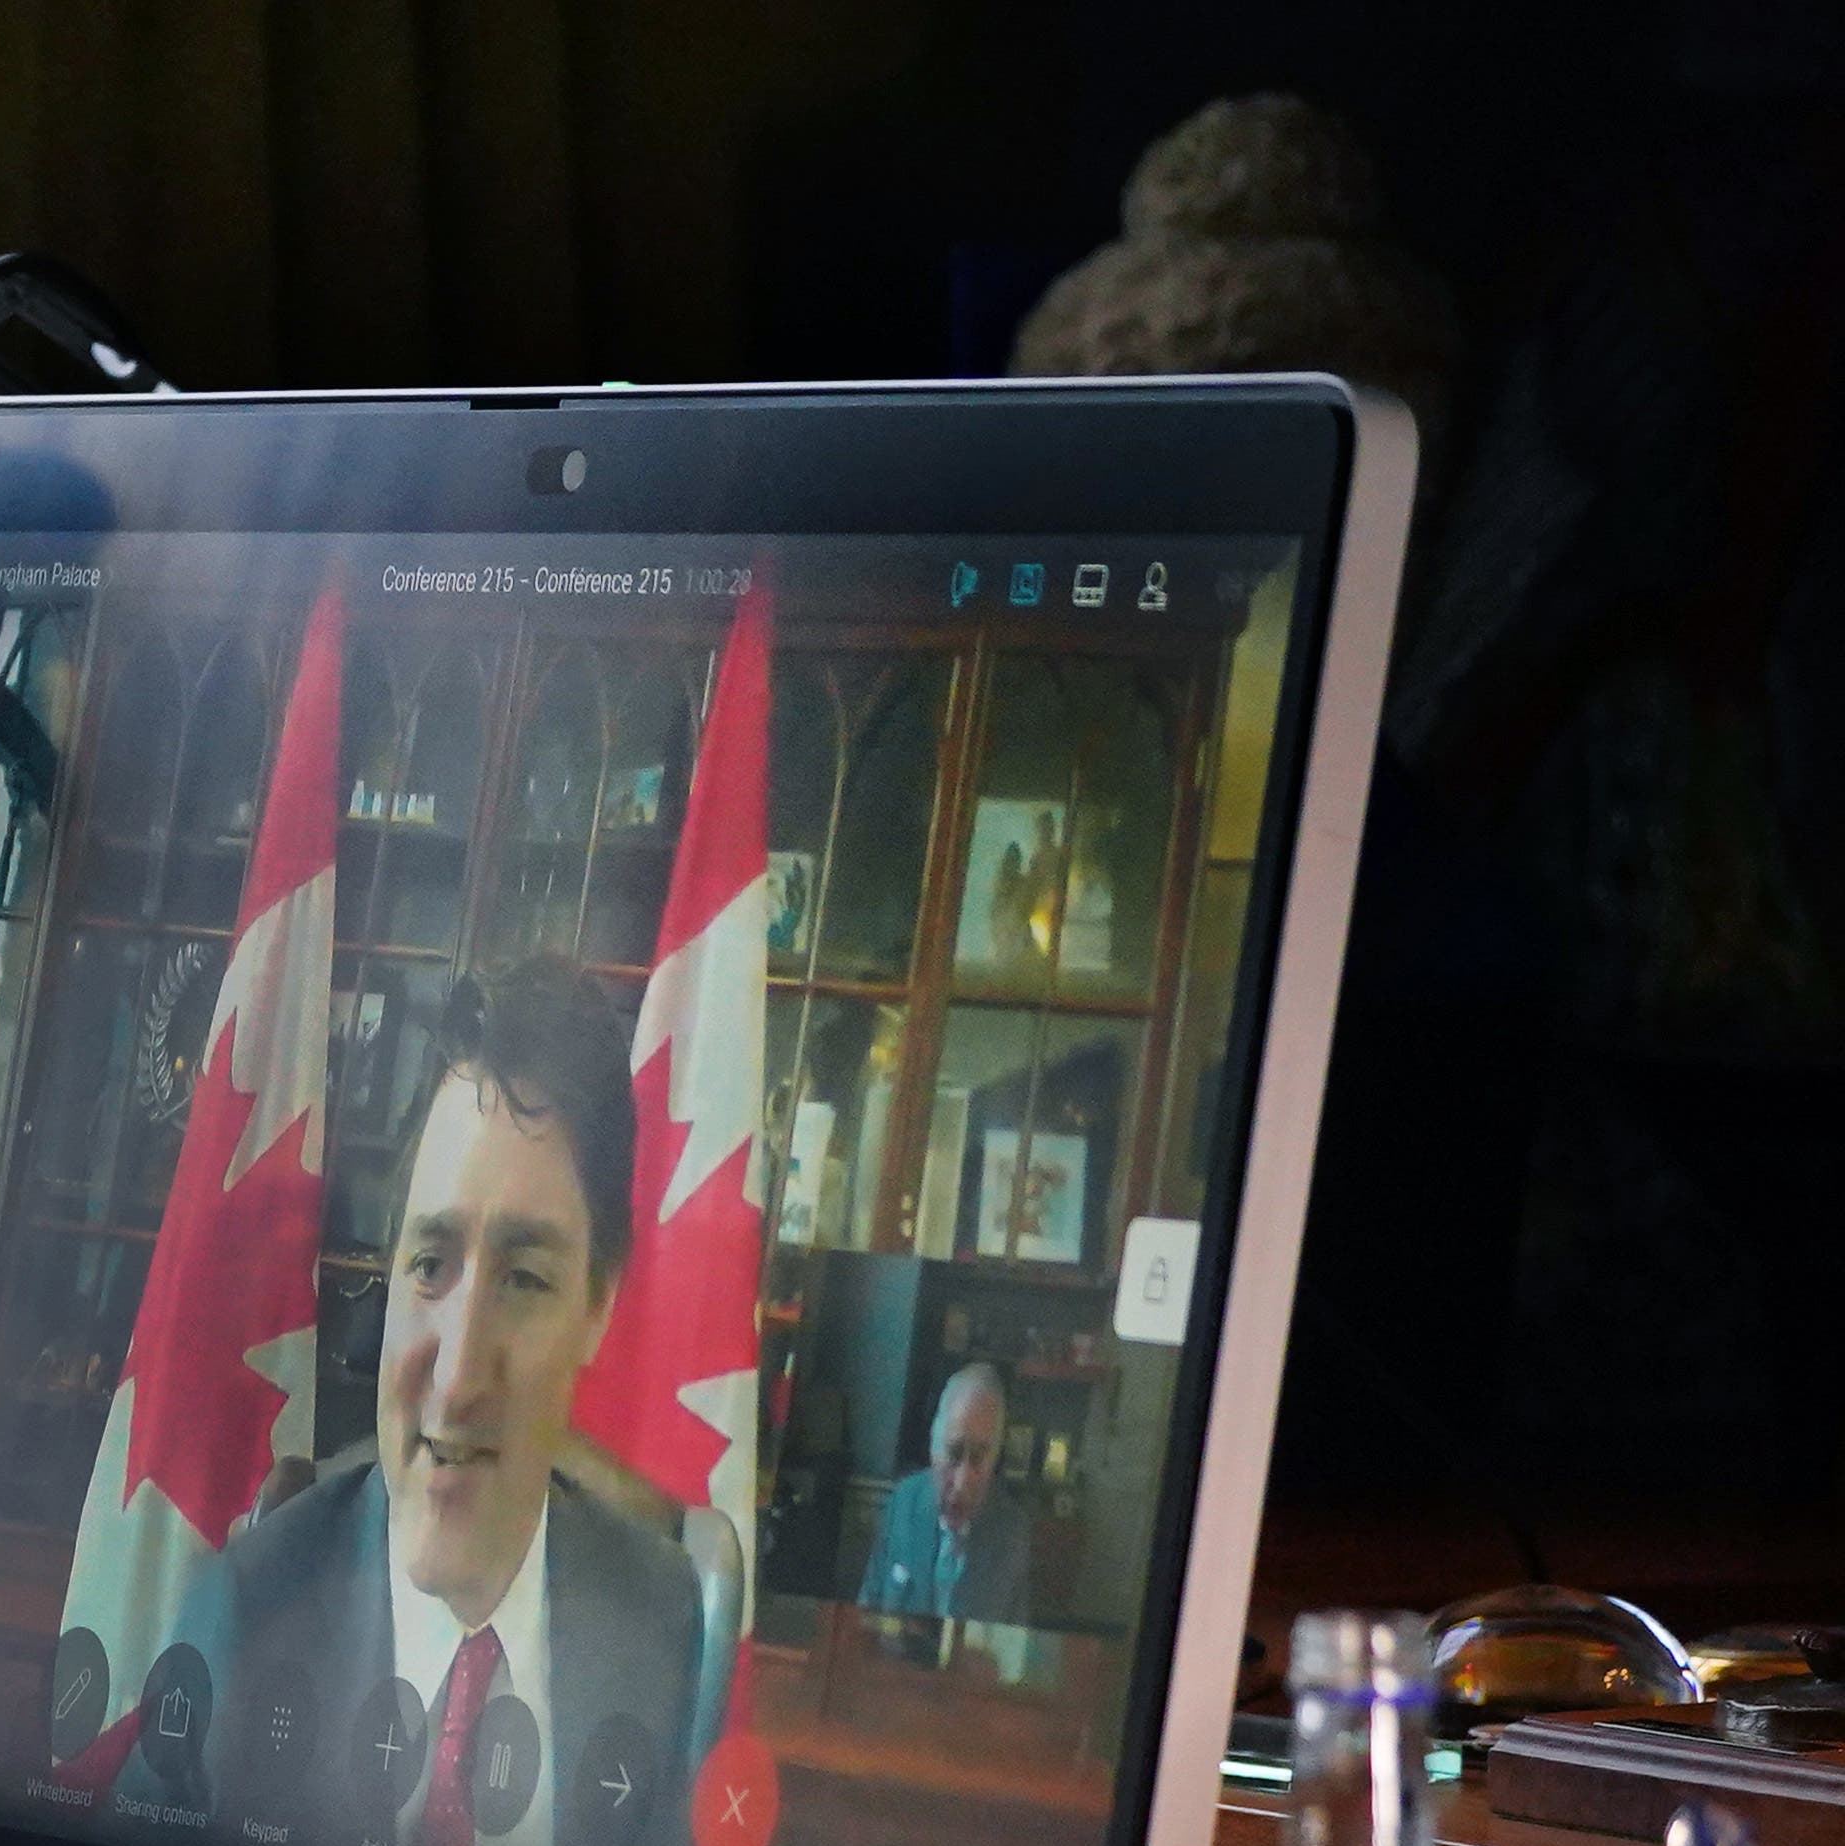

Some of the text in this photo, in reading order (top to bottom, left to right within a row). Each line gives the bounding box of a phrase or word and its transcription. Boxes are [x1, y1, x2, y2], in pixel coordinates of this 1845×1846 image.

[52, 562, 101, 587] Palace
[382, 565, 477, 593] Conference
[481, 566, 515, 593] 215
[535, 566, 634, 594] Conférence
[638, 567, 674, 595] 215
[26, 1778, 94, 1807] Whiteboard
[243, 1816, 290, 1844] Keypad
